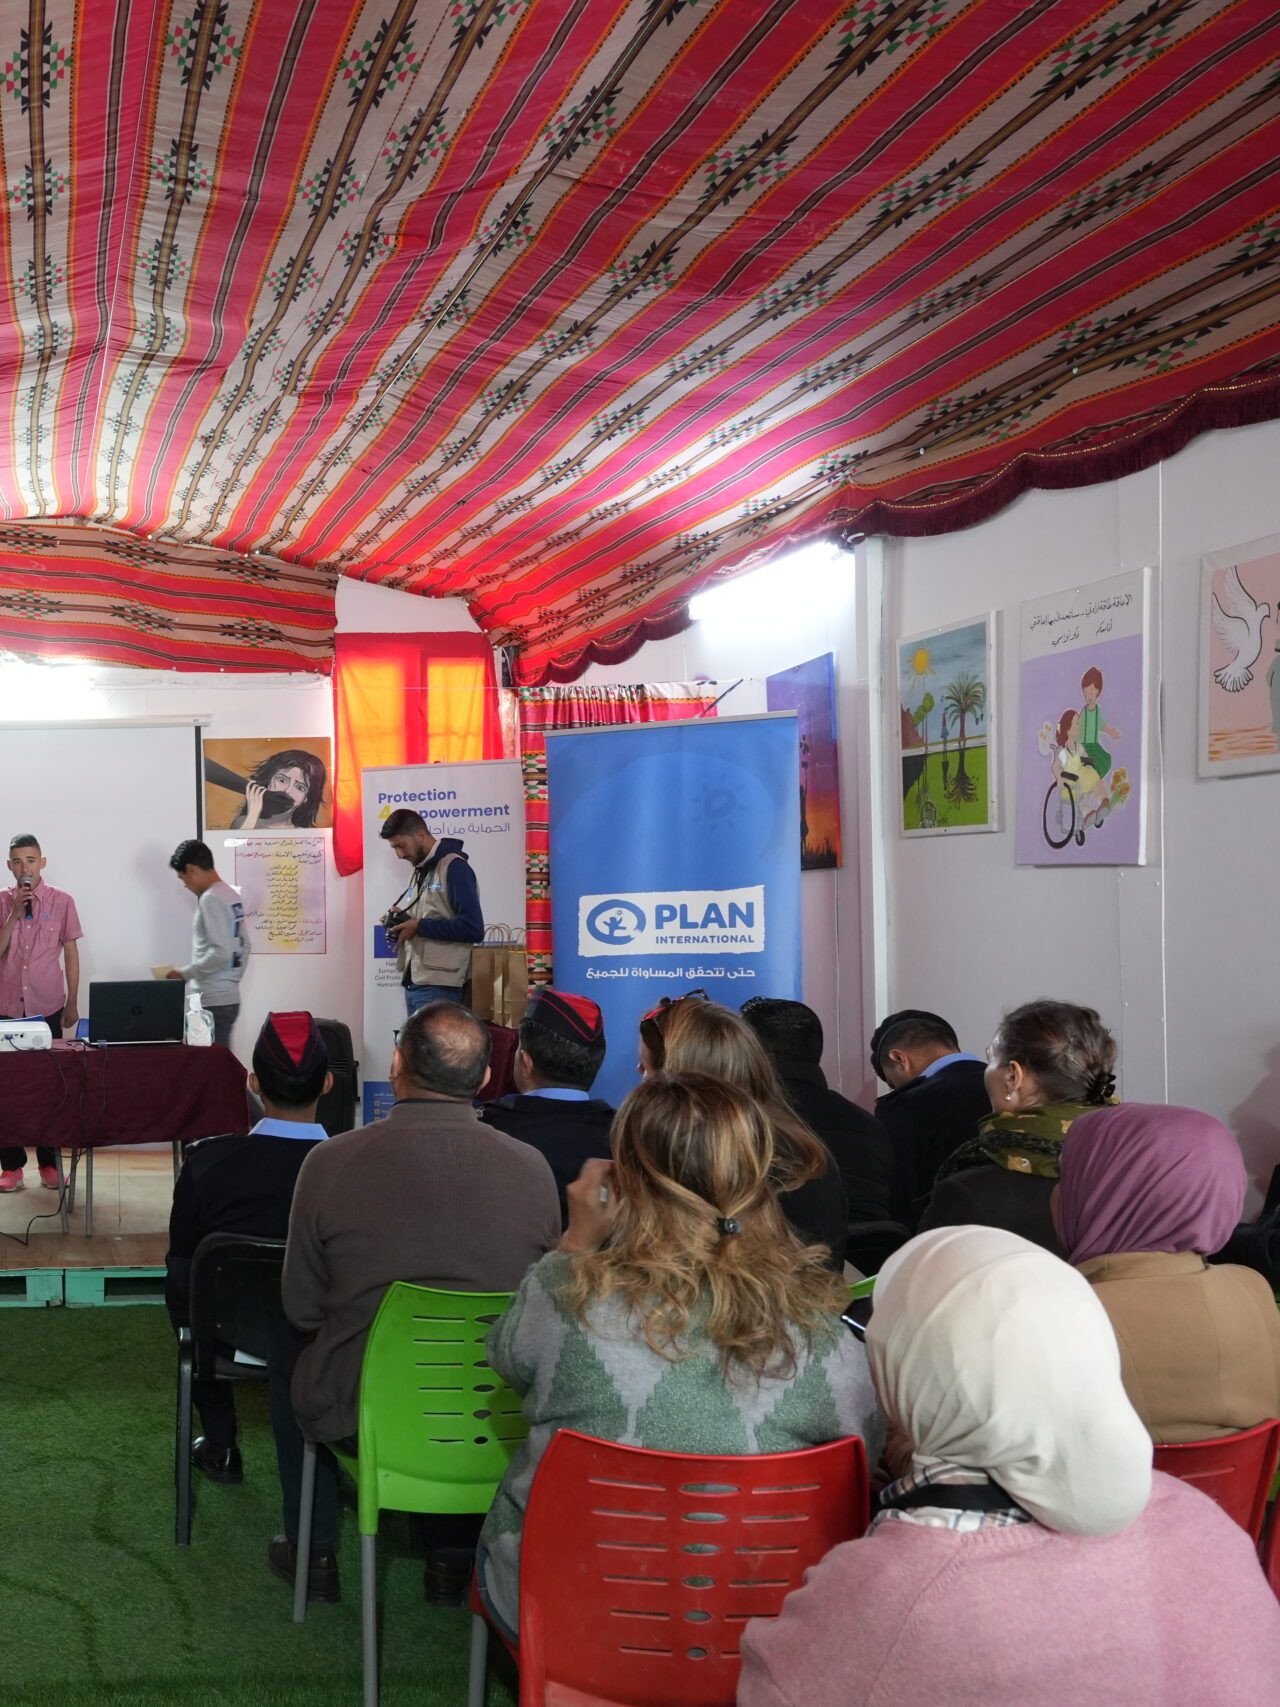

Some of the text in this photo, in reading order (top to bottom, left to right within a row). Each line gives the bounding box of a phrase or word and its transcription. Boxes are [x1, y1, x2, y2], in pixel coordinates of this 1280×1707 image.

[378, 788, 457, 804] Protection
[419, 803, 510, 819] powerment
[468, 822, 510, 834] الحماية
[655, 901, 754, 930] PLAN
[656, 934, 755, 944] INTERNATIONAL
[586, 966, 756, 980] حتى تتحقق المساواة للجميع
